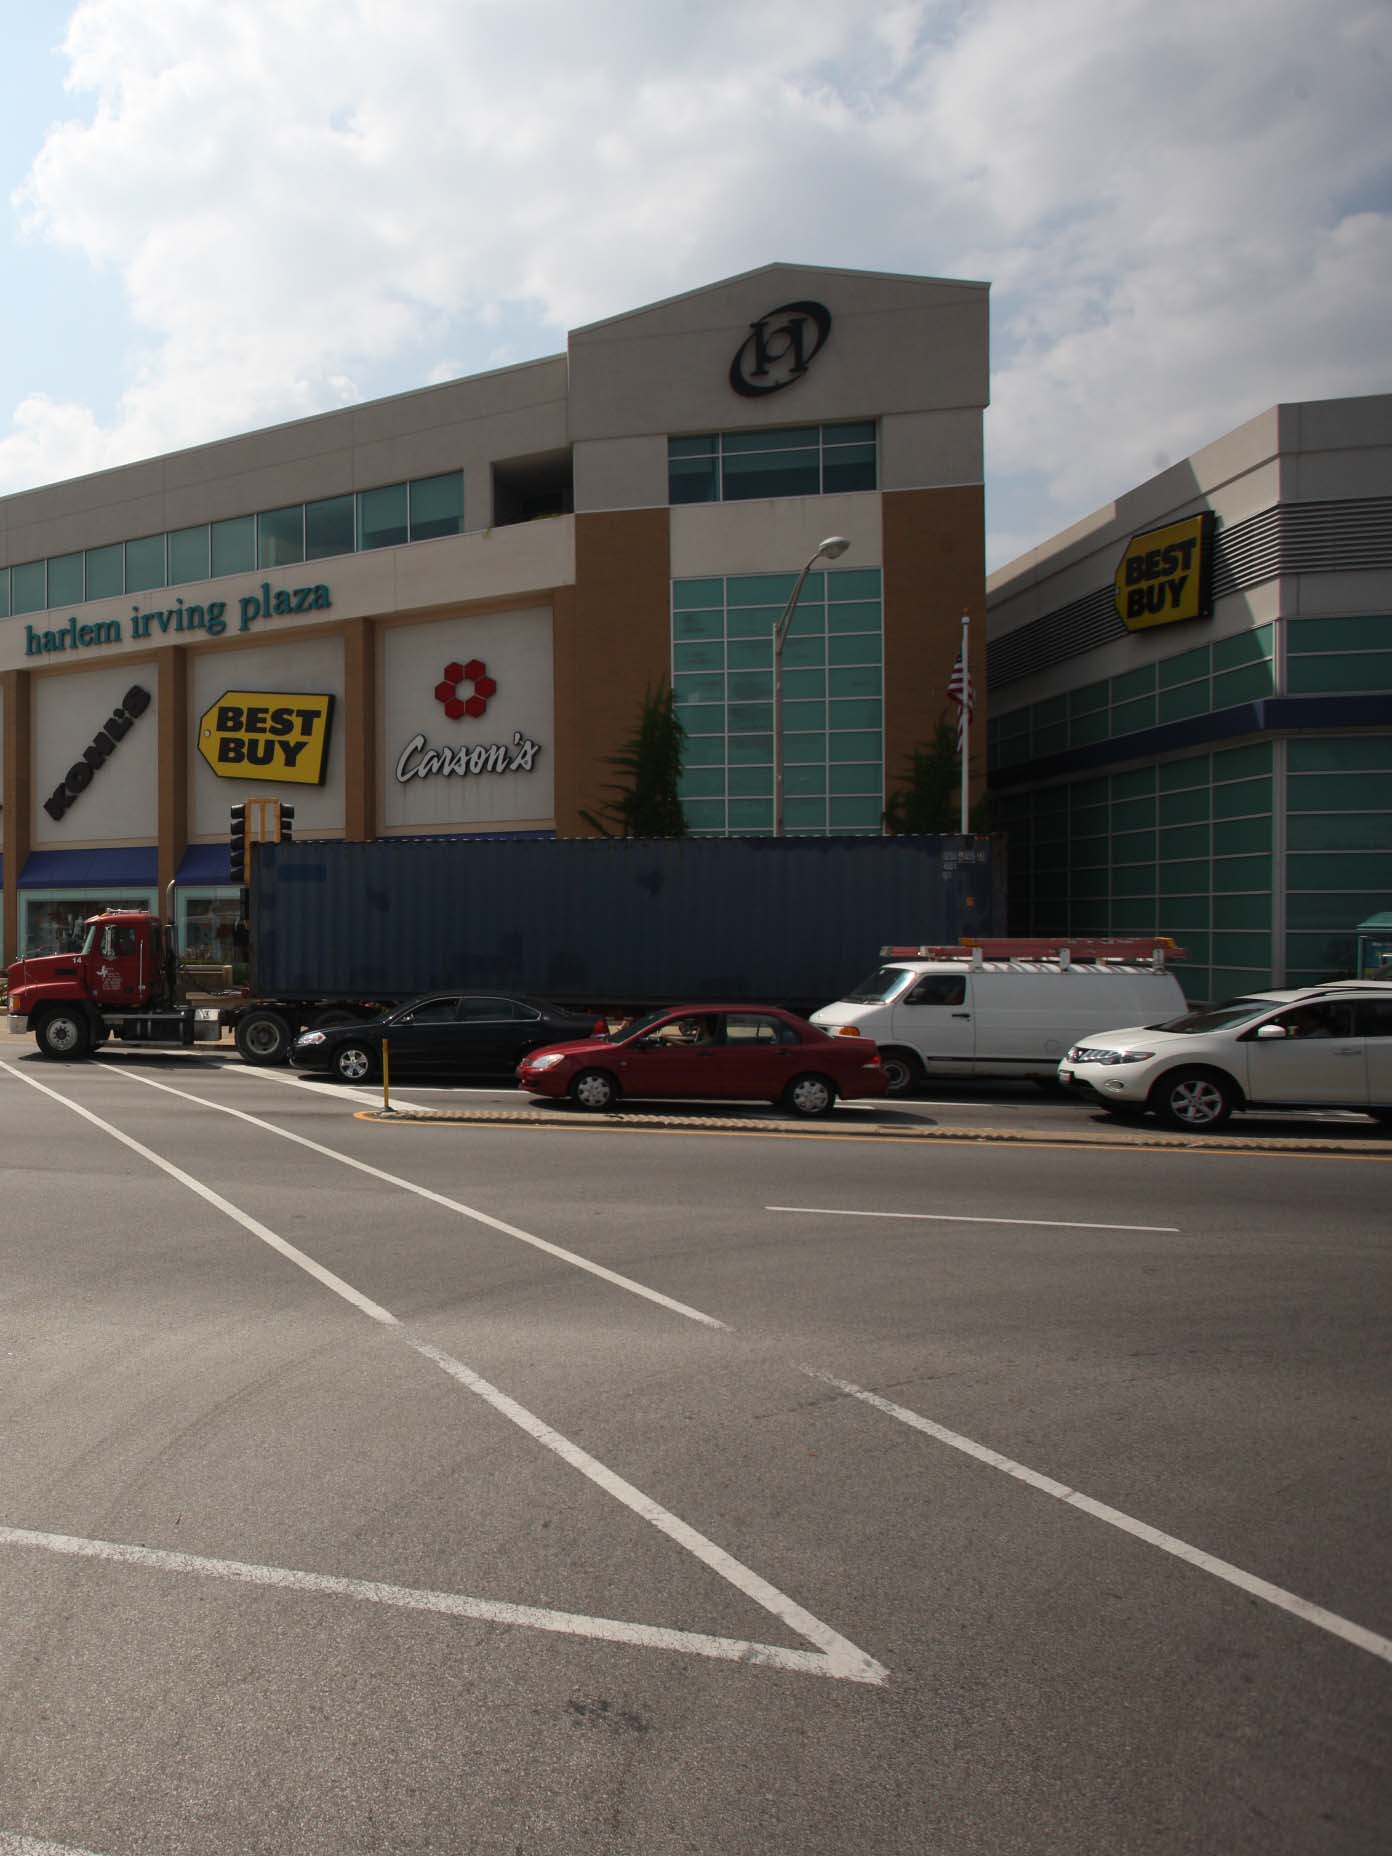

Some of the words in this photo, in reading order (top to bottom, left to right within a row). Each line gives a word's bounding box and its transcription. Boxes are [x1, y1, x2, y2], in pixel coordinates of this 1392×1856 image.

[1124, 537, 1197, 587] BEST
[24, 616, 123, 656] harlem
[131, 598, 227, 636] irving
[237, 581, 333, 632] plaza
[1127, 575, 1190, 618] BUY
[215, 705, 322, 737] BEST
[43, 684, 152, 822] KOHL'S
[218, 737, 309, 768] BUY
[396, 730, 542, 784] Carson's
